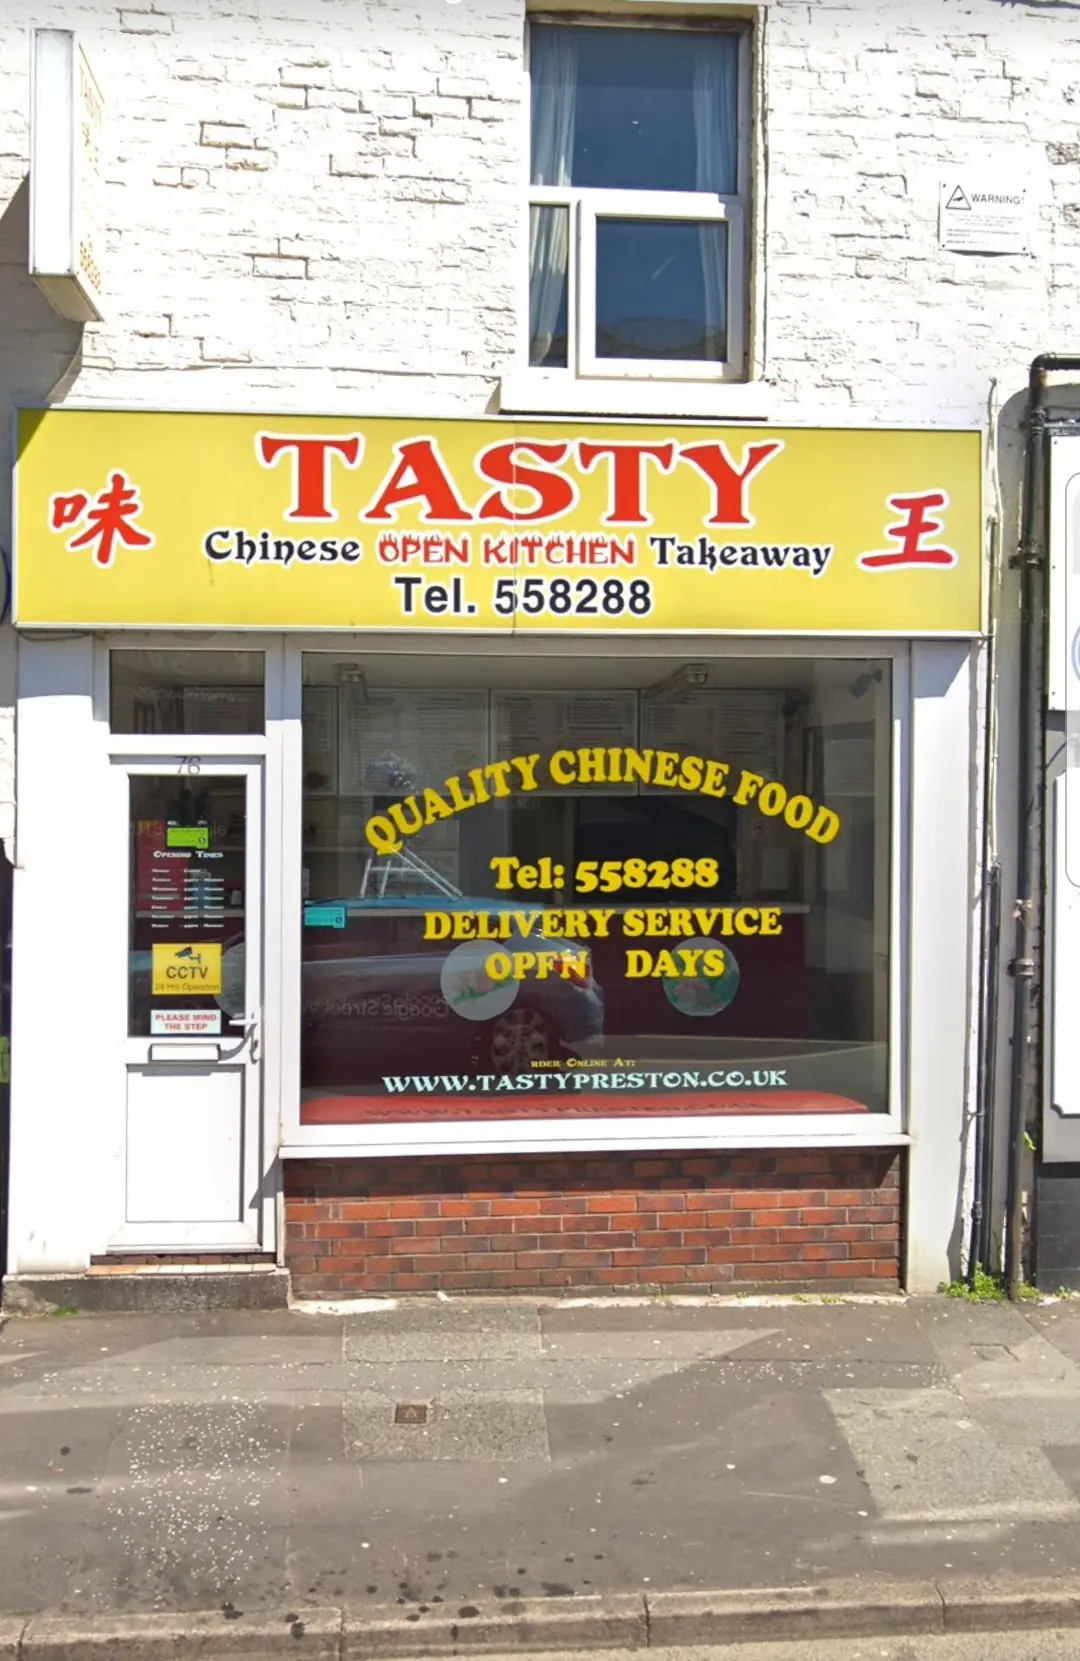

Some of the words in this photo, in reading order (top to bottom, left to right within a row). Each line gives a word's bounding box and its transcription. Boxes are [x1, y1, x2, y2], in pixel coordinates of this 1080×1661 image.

[261, 436, 779, 524] TASTY
[53, 473, 151, 564] 味
[862, 493, 953, 567] 王
[205, 530, 361, 565] Chinese
[379, 534, 468, 563] OPEN
[484, 536, 634, 564] KITCHEN
[650, 537, 831, 575] Takeaway
[394, 577, 476, 613] Tel.
[495, 578, 651, 614] 558288
[175, 755, 201, 774] 76
[365, 753, 541, 856] QUALITY
[549, 747, 730, 799] CHINESE
[732, 769, 841, 844] FOOD
[490, 856, 565, 890] Tel:
[575, 857, 720, 893] 558288
[423, 908, 616, 940] DELIVERY
[622, 907, 783, 937] SERVICE
[166, 965, 209, 980] CCTV
[625, 948, 726, 978] DAYS
[183, 982, 220, 993] Operation
[155, 1013, 190, 1021] PLEASE
[192, 1013, 217, 1021] MIND
[164, 1023, 182, 1031] THE
[184, 1023, 208, 1031] STEP
[381, 1069, 788, 1093] WWW.TASTYPRESTON.CO.UK
